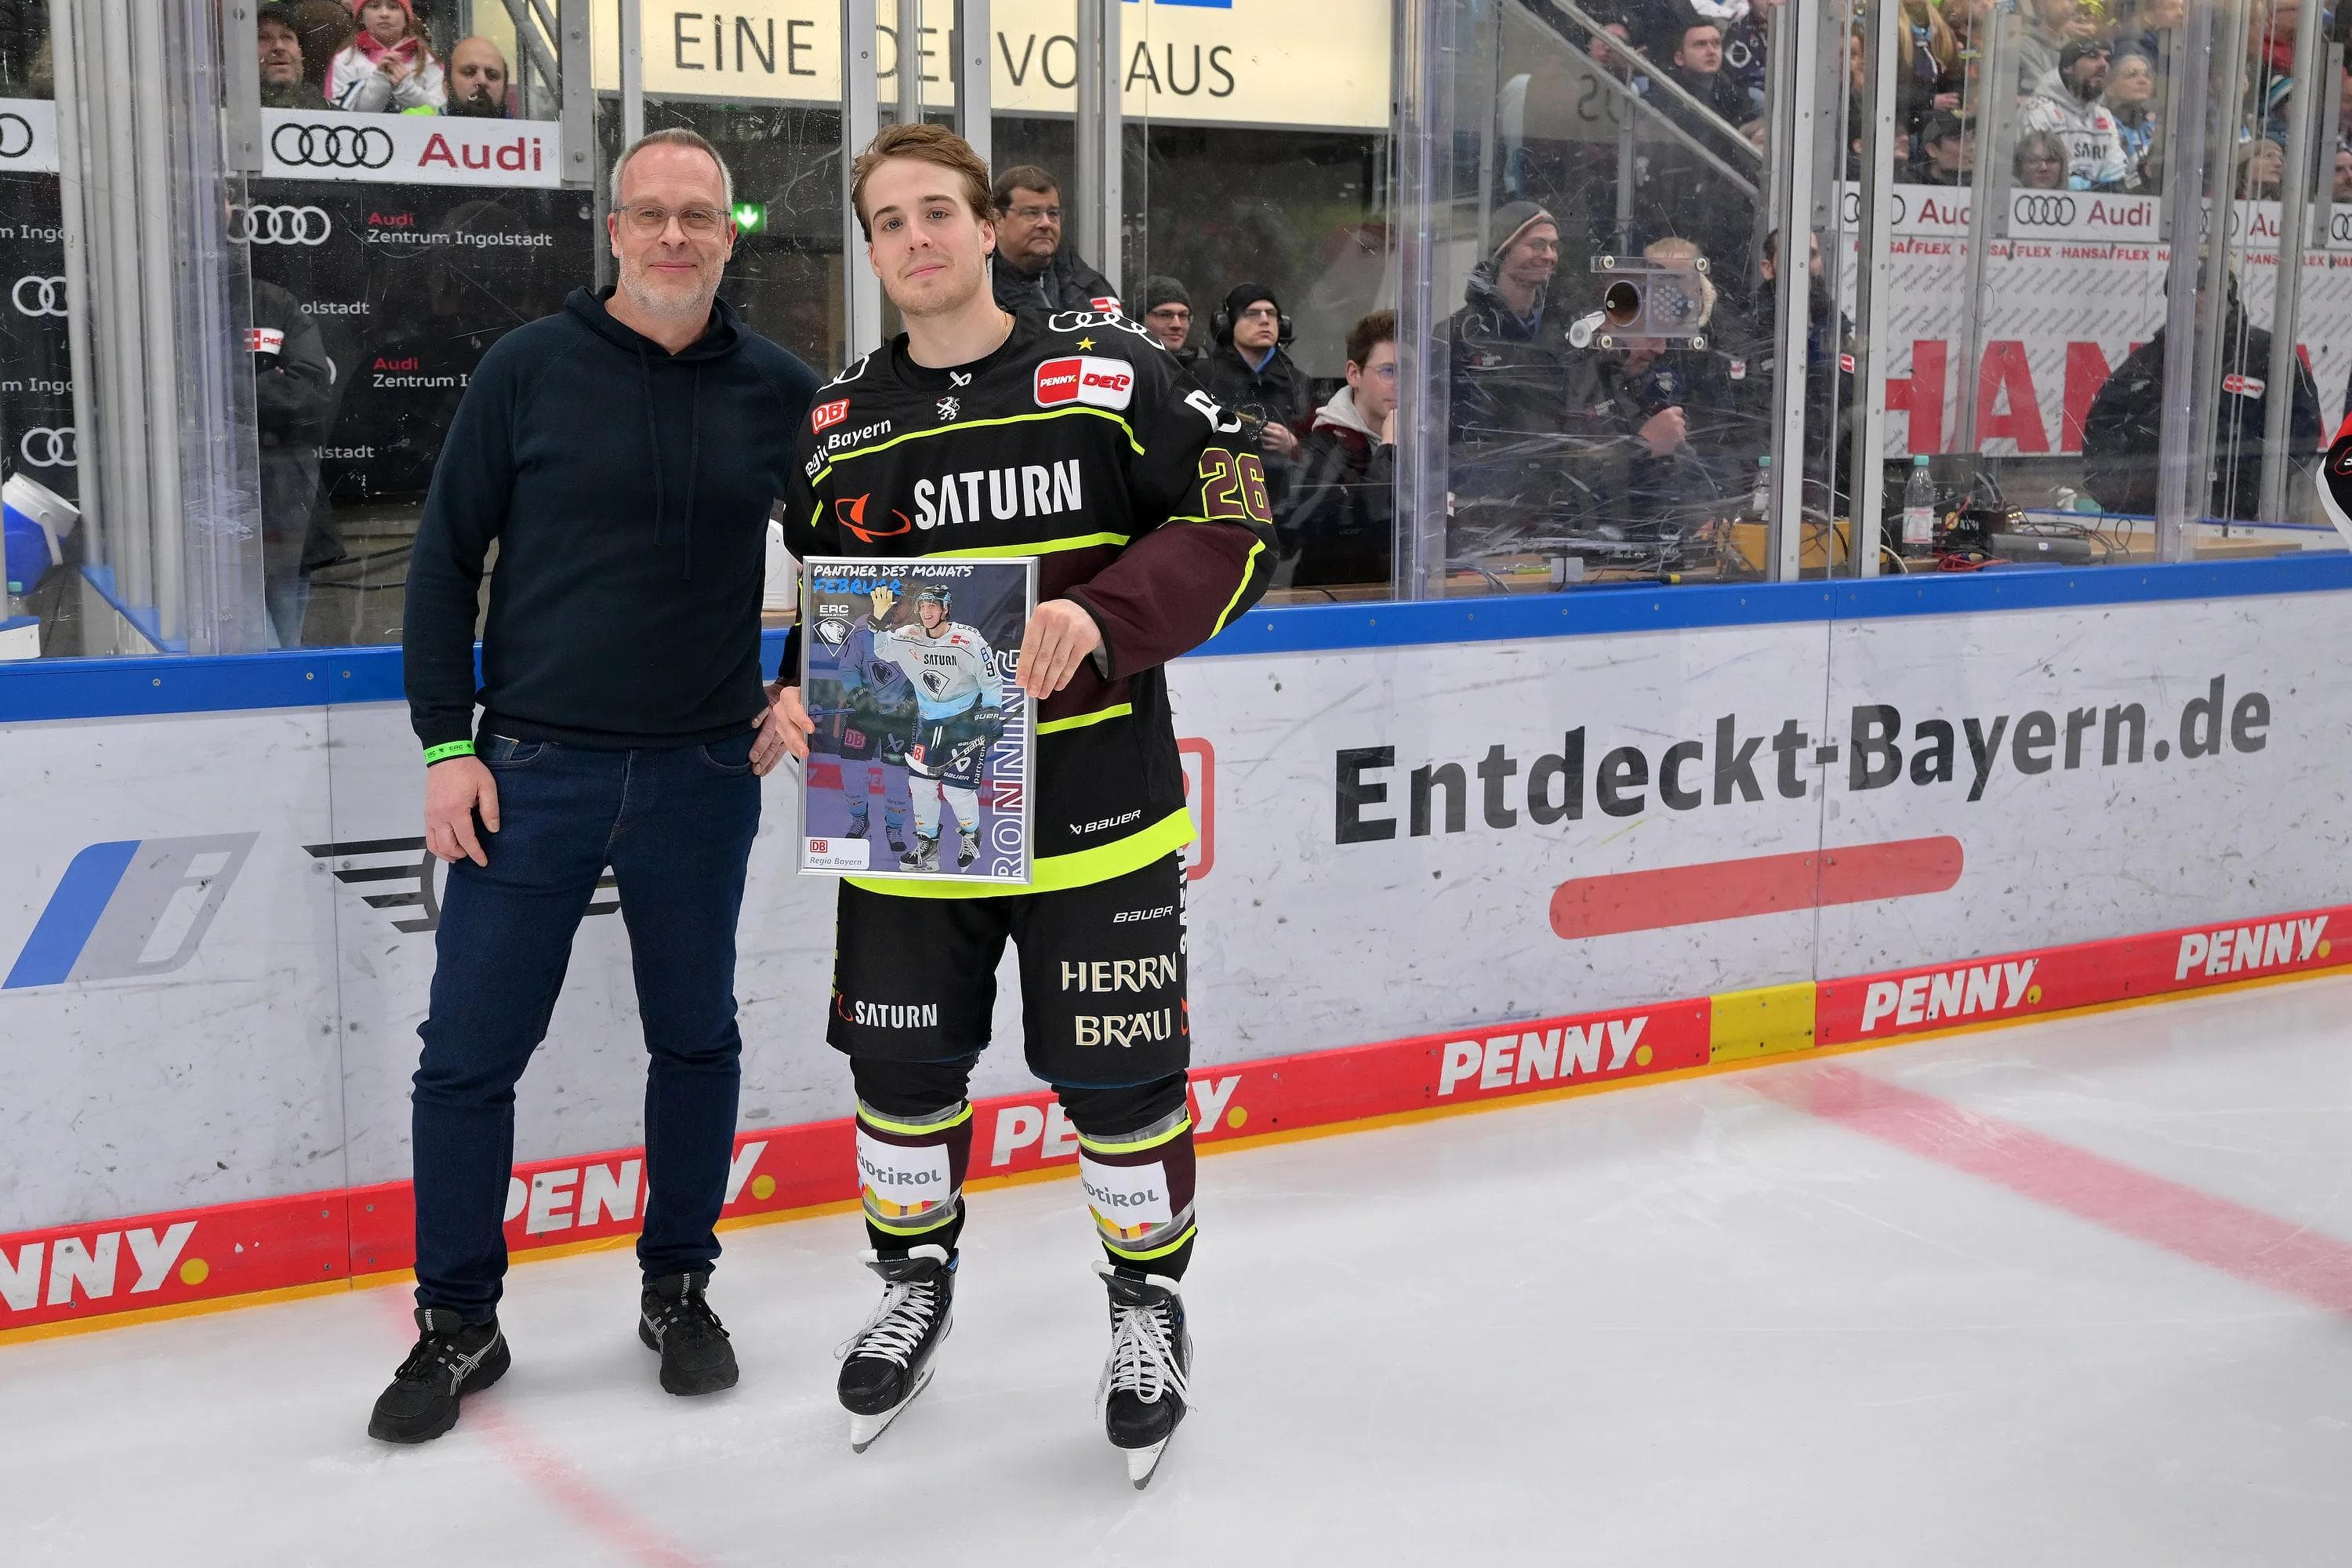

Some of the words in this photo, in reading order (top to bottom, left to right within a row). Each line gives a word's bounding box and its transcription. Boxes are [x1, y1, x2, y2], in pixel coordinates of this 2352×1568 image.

[676, 12, 816, 76] EINE
[877, 24, 954, 82] DE
[997, 31, 1236, 97] VOAUS
[417, 132, 542, 171] Audi
[368, 212, 414, 226] Audi
[2086, 201, 2152, 227] Audi
[368, 228, 450, 244] Zentrum
[456, 230, 553, 248] Ingolstadt
[373, 357, 419, 371] Audi
[373, 374, 454, 387] Zentrum
[813, 402, 846, 429] DB
[827, 419, 891, 450] Bayern
[914, 459, 1082, 531] SATURN
[1198, 447, 1273, 525] 26
[814, 564, 878, 577] PANTHER
[882, 564, 909, 577] DES
[912, 564, 974, 577] MONATS
[819, 604, 849, 614] ERC
[924, 653, 958, 666] SATURN
[991, 649, 1025, 877] RONNING
[1335, 673, 2271, 846] Entdeckt-Bayern.de
[811, 842, 826, 851] DB
[809, 856, 832, 867] Regio
[833, 858, 862, 866] Bayern
[1061, 950, 1177, 993] HERRN
[855, 1002, 937, 1028] SATURN
[1075, 1007, 1171, 1047] BRÄU
